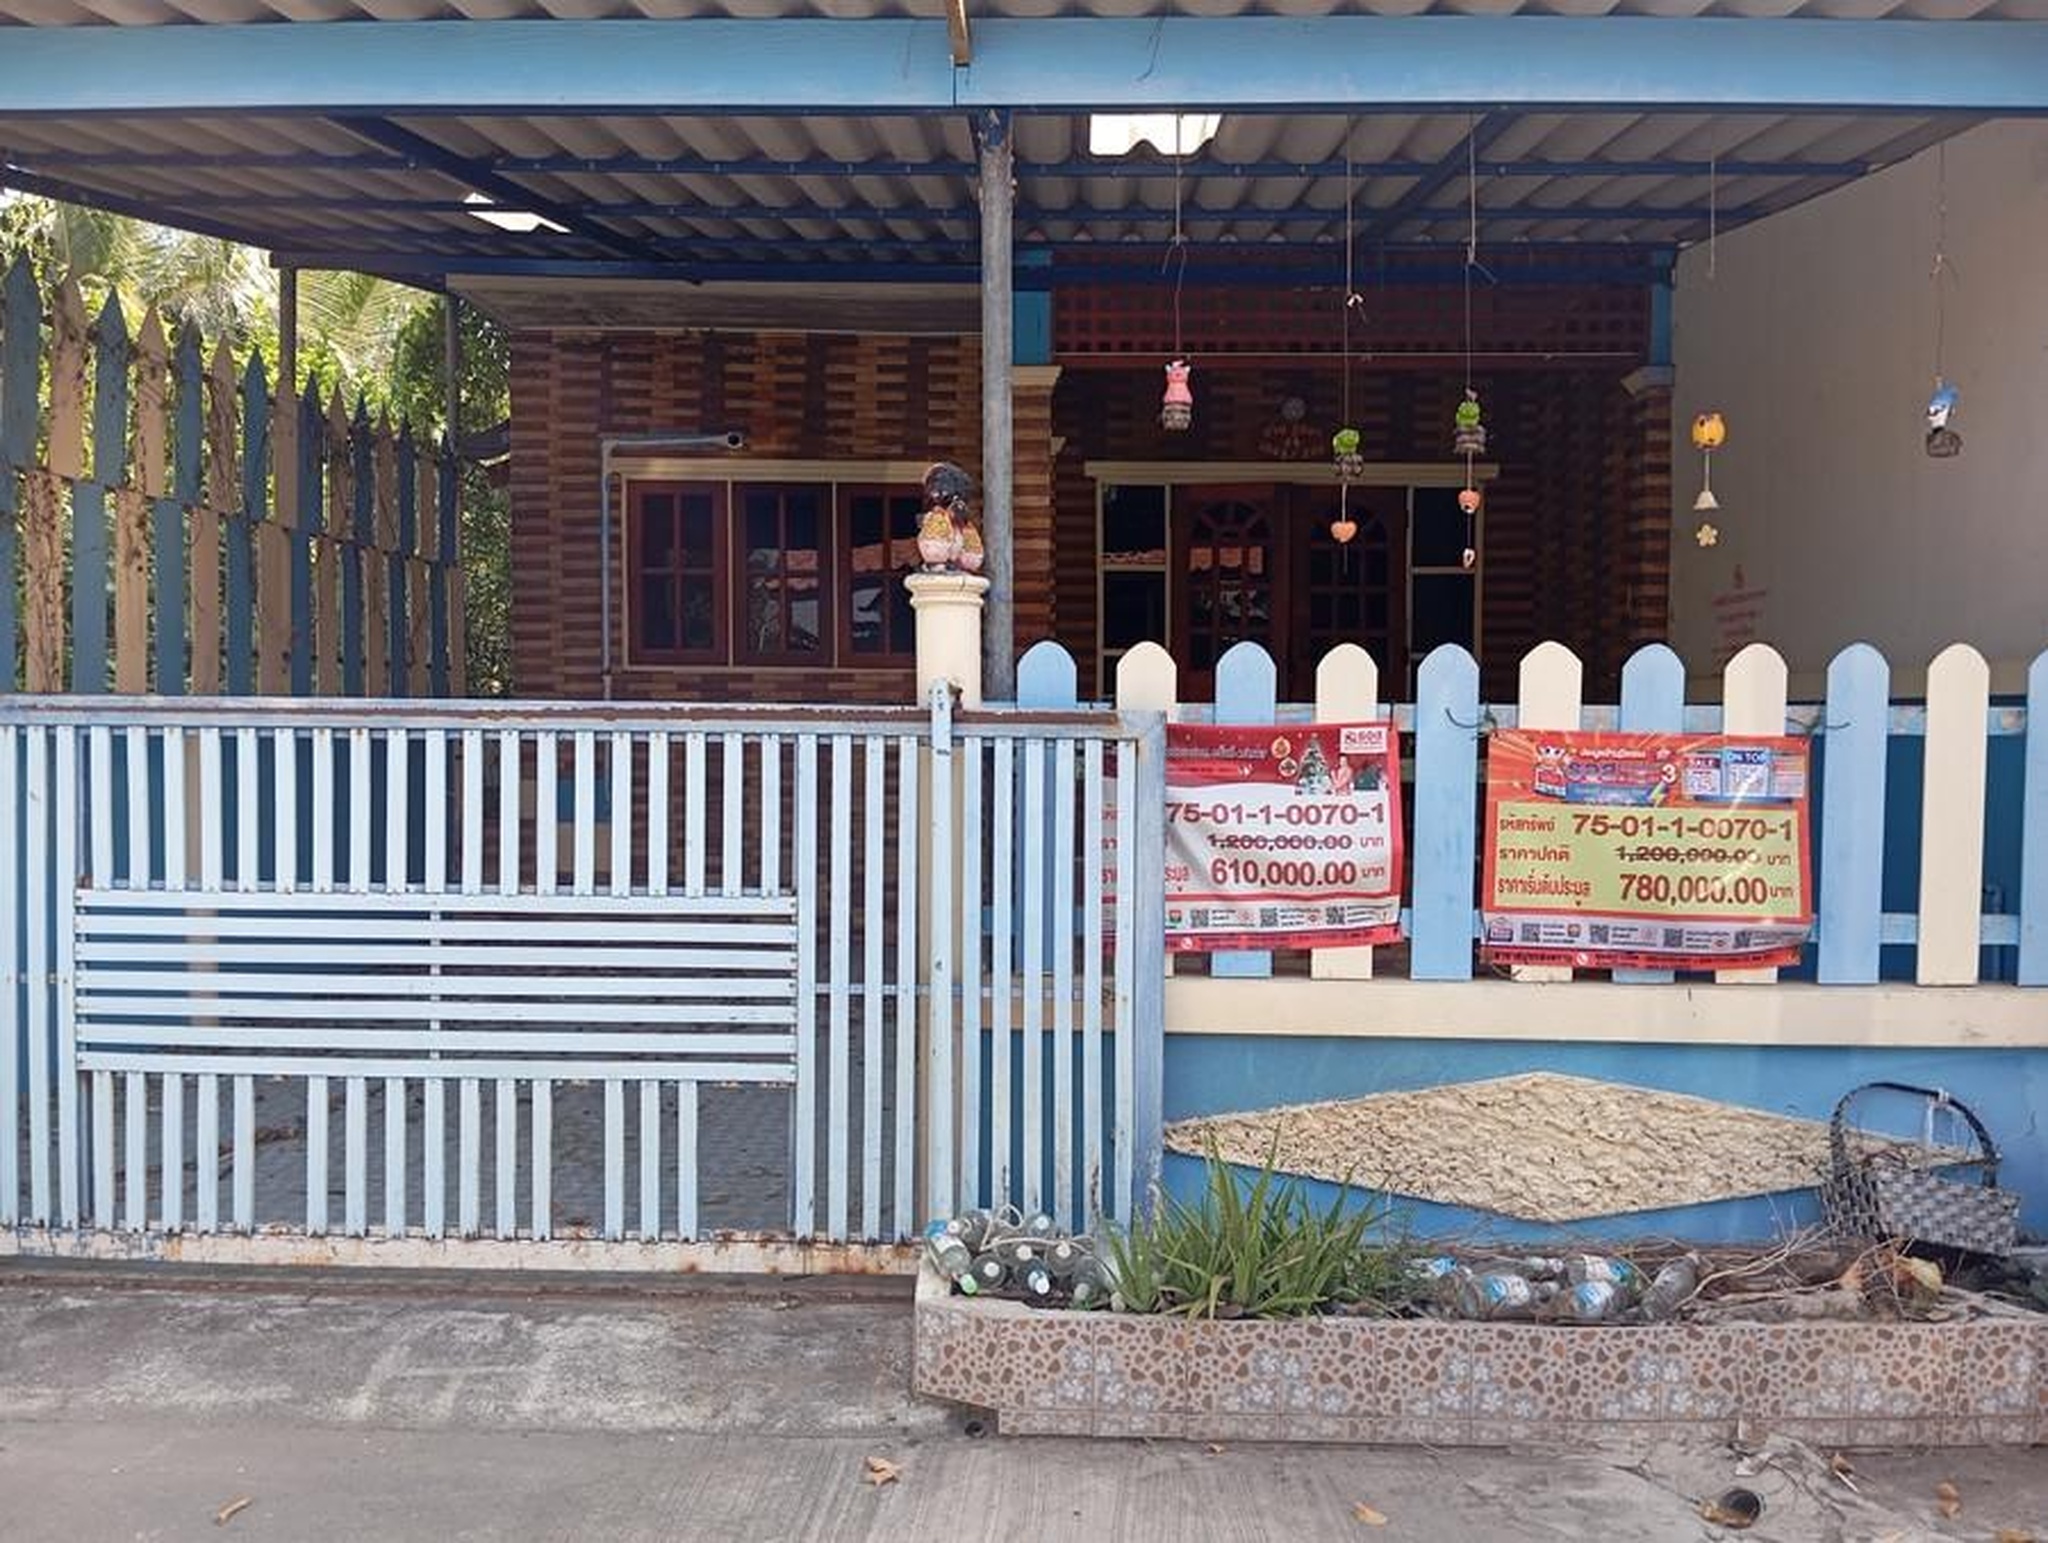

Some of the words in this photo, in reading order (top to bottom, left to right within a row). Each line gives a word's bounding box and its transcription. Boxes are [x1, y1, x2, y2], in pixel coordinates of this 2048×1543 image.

[1661, 763, 1677, 784] 3
[1165, 802, 1384, 825] 75-01-1-0070-1
[1572, 813, 1792, 841] 75-01-1-0070-1
[1211, 857, 1356, 887] 610,000.00
[1619, 872, 1767, 905] 780,000.00
